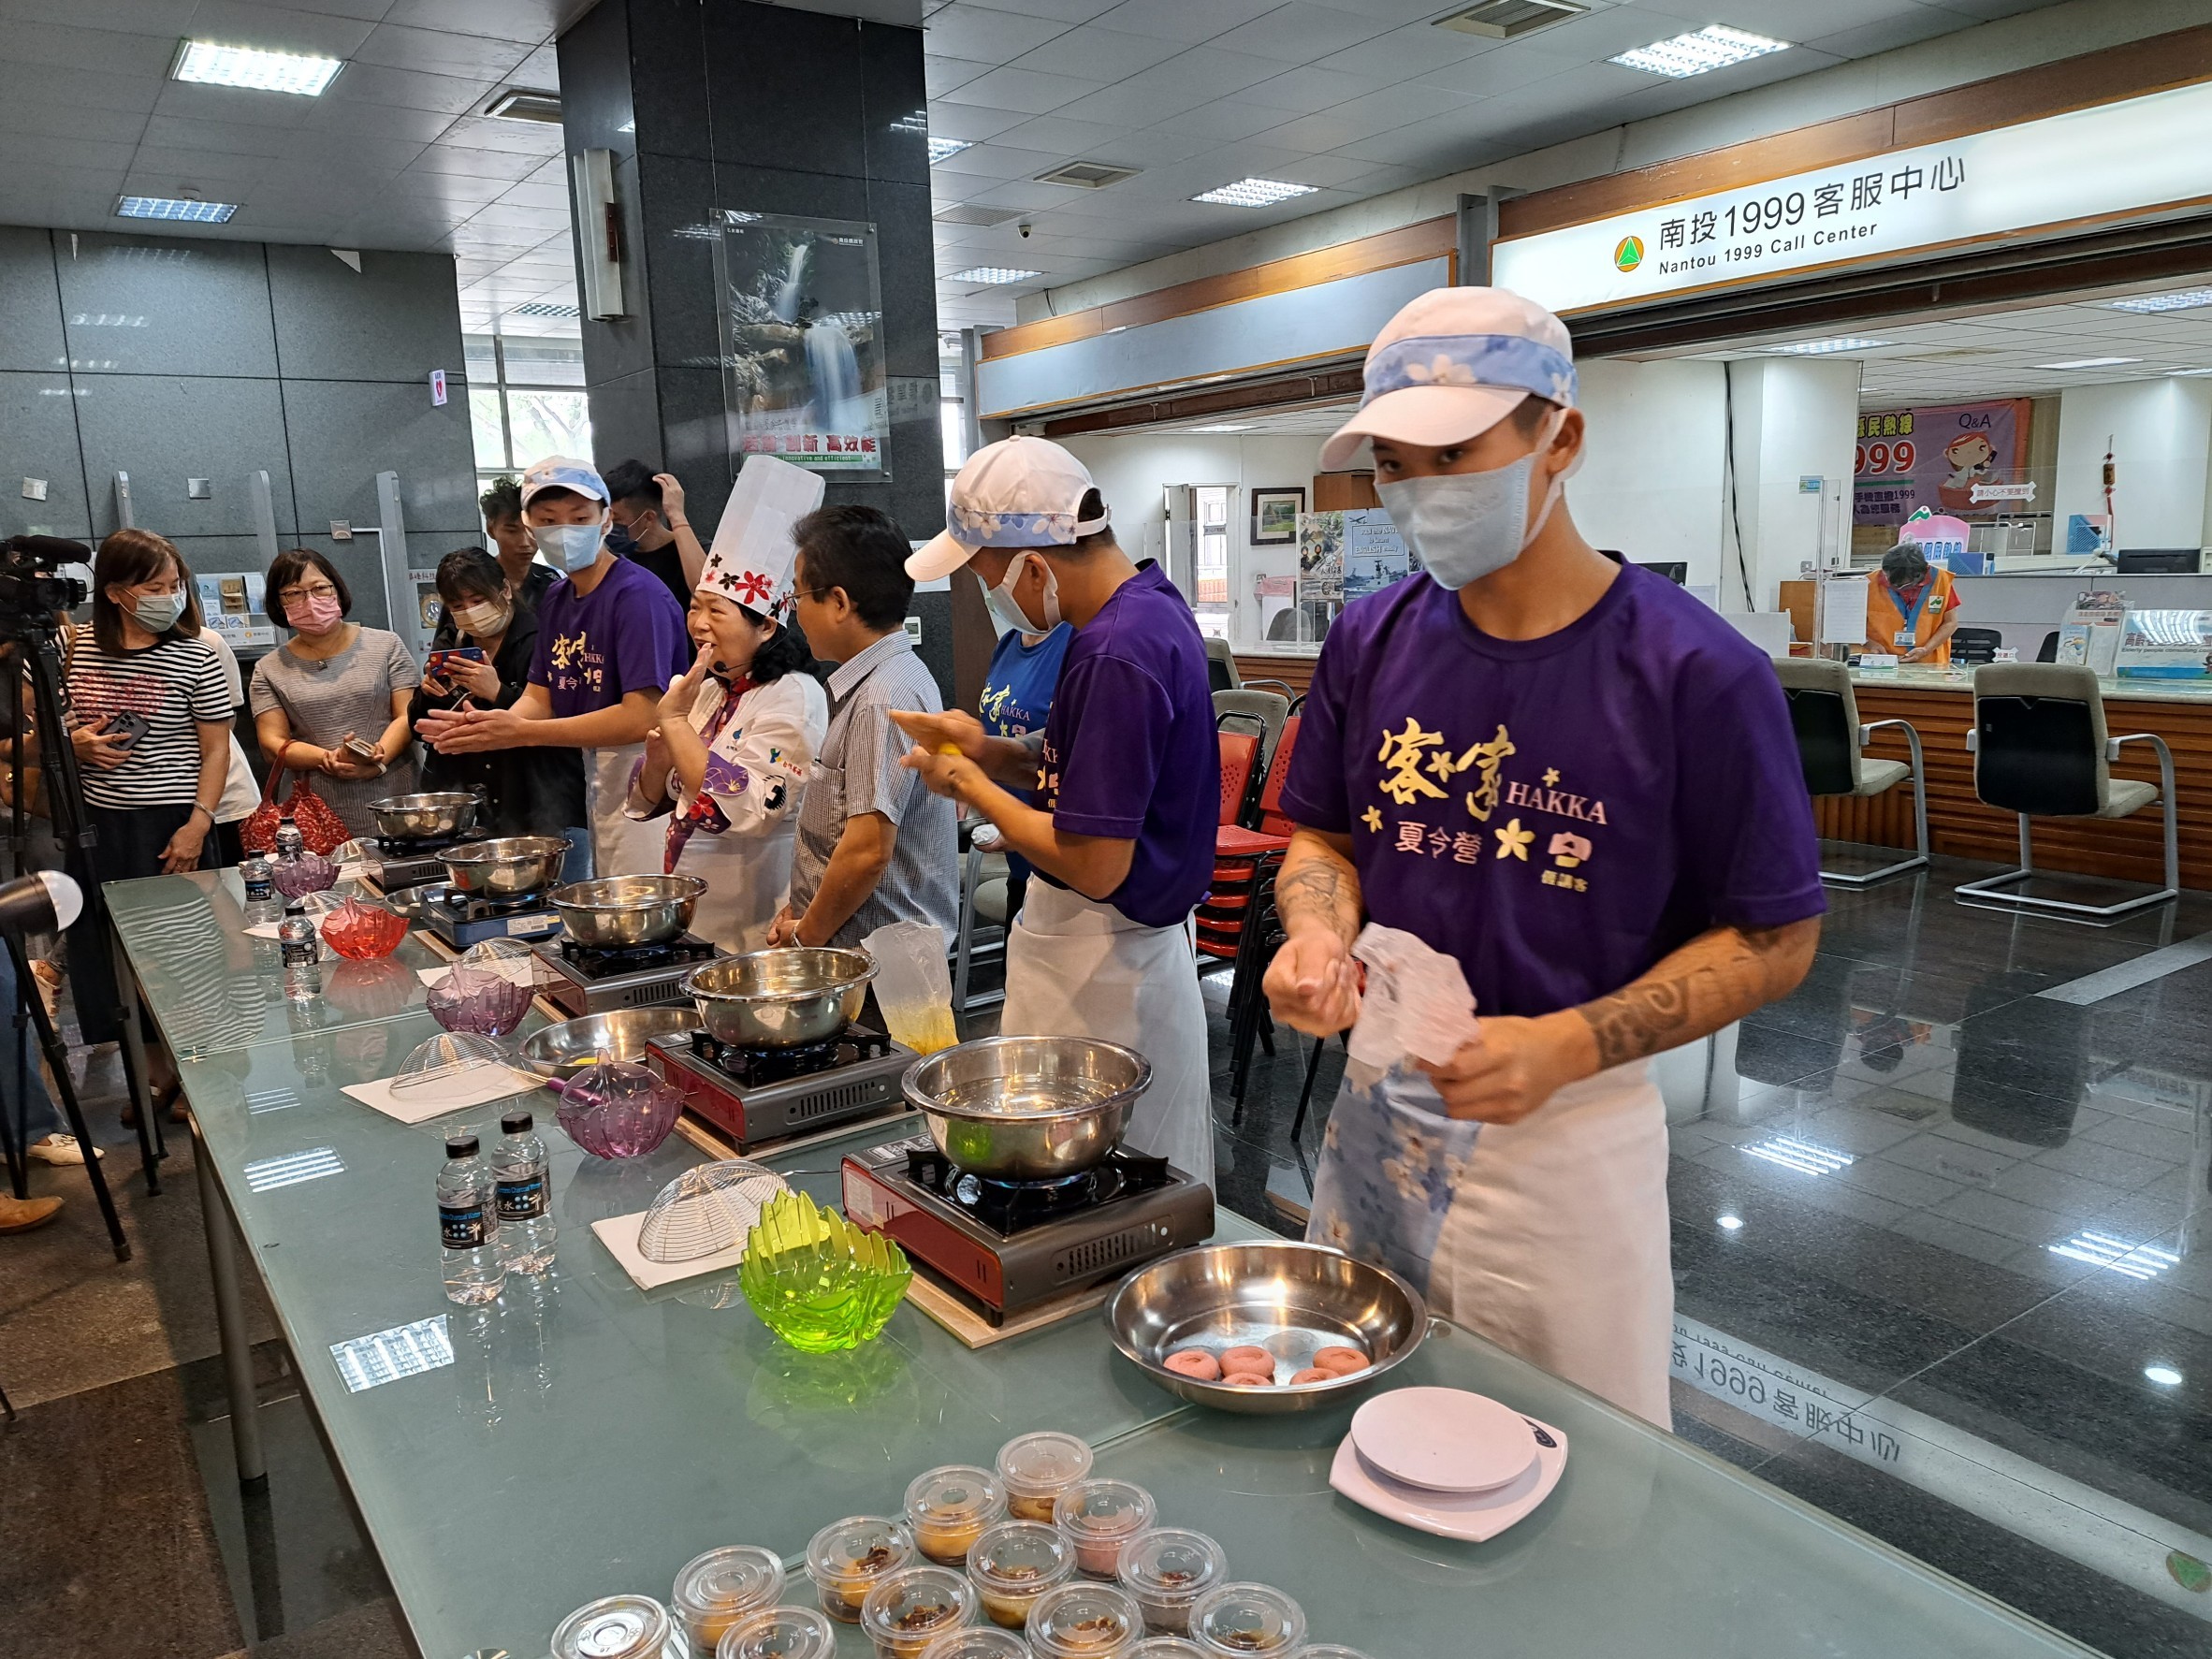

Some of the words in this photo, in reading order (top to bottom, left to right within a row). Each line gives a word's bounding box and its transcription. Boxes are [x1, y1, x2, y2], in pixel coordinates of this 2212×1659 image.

[1658, 156, 1966, 251] 南投1999客服中心
[1658, 254, 1716, 275] Nantou
[1724, 243, 1763, 263] 1999
[1770, 234, 1805, 254] Call
[1813, 222, 1878, 246] Center
[1958, 413, 1991, 429] Q&A
[1000, 705, 1030, 721] HAKKA
[1506, 780, 1608, 825] HAKKA
[1394, 821, 1482, 865] 夏令營
